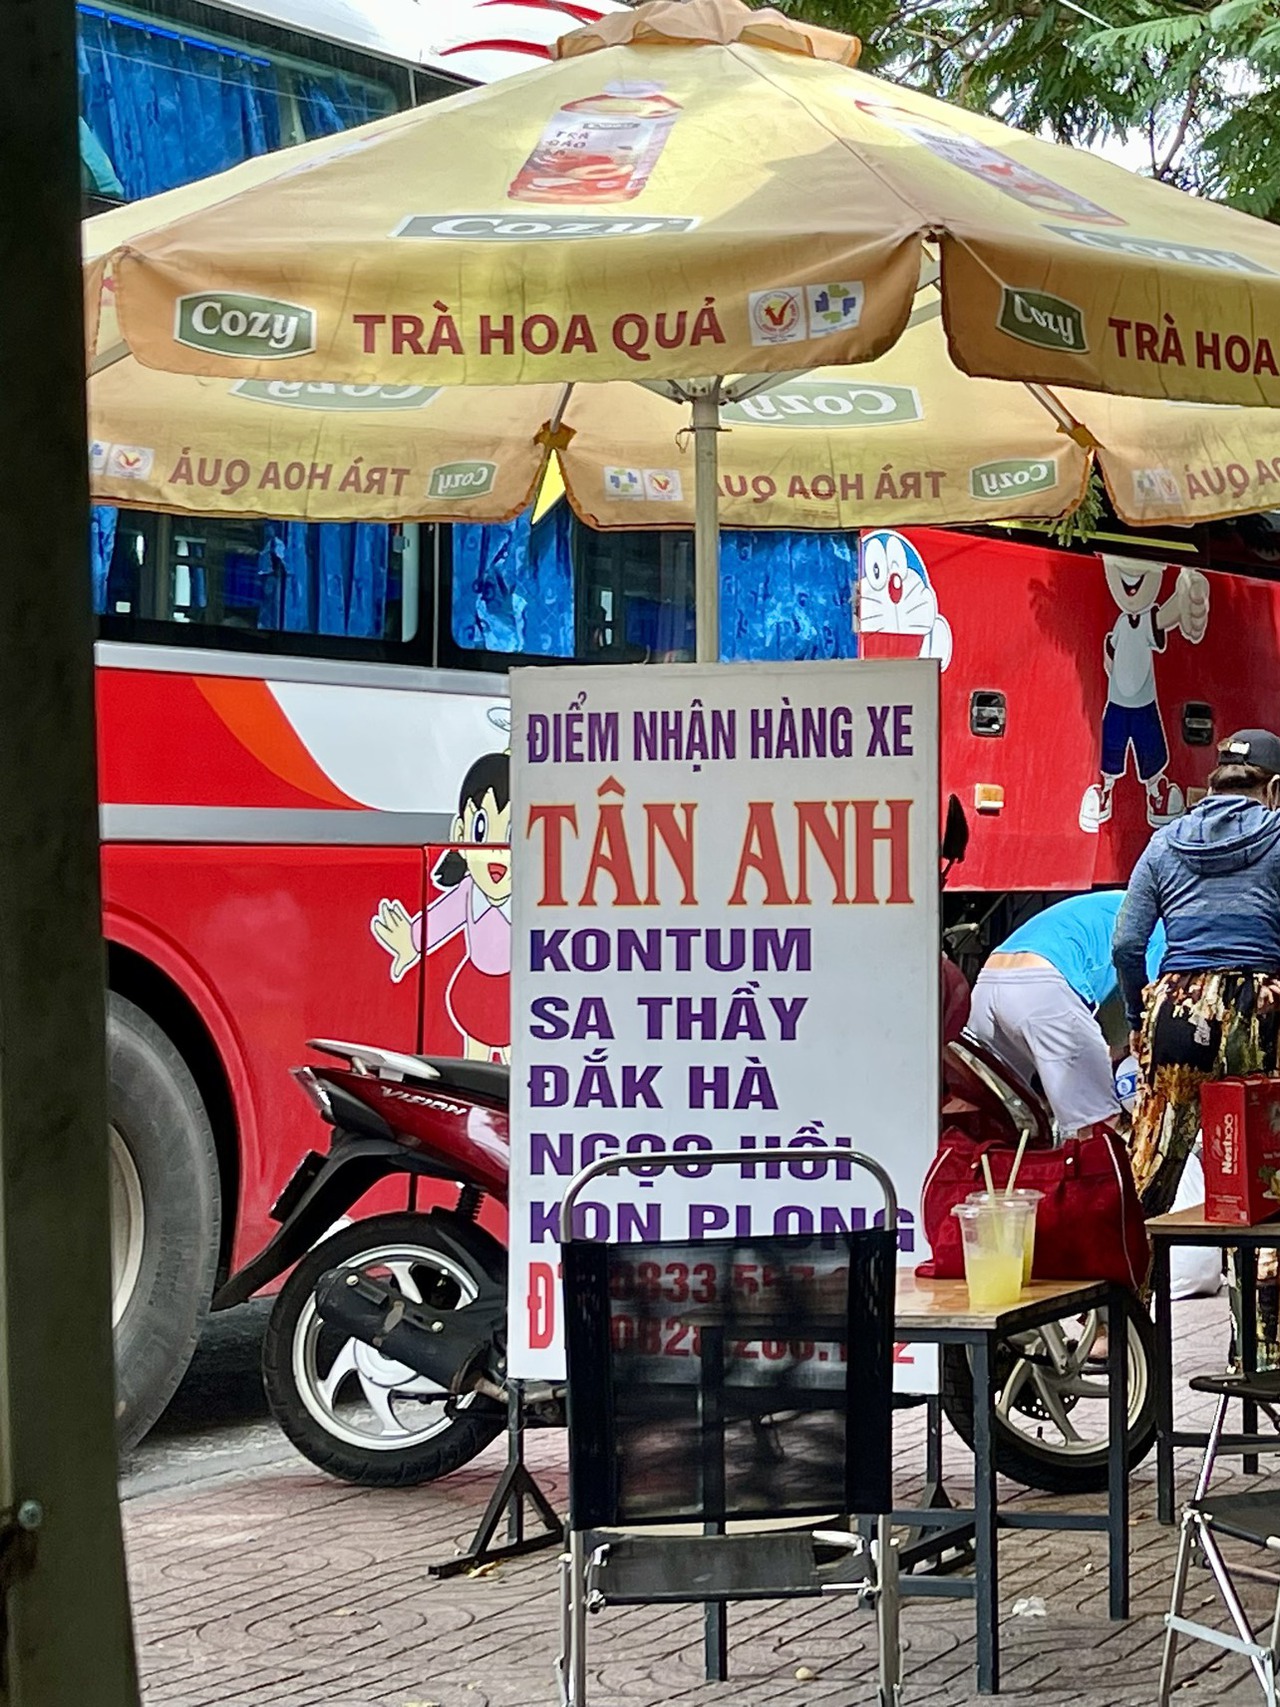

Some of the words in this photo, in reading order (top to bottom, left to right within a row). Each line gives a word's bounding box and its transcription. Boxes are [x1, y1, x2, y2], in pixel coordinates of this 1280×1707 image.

[431, 216, 661, 236] Cozy
[191, 301, 298, 349] Cozy
[353, 300, 463, 355] TRÀ
[480, 313, 598, 355] HOA
[612, 296, 726, 361] QUẢ
[1013, 293, 1074, 346] Cozy
[1108, 313, 1186, 366] TRÀ
[1195, 330, 1280, 377] HOA
[527, 691, 619, 763] ĐIỂM
[633, 699, 736, 772] NHẬN
[750, 696, 853, 759] HÀNG
[866, 705, 914, 758] XE
[526, 774, 699, 907] TÂN
[727, 799, 915, 906] ANH
[529, 928, 812, 972] KONTUM
[529, 996, 615, 1041] SA
[637, 981, 809, 1041] THẦY
[527, 1048, 663, 1109] ĐẮK
[688, 1056, 779, 1110] HÀ
[530, 1133, 713, 1188] NGỌC
[740, 1120, 852, 1180] HỒI
[530, 1201, 662, 1244] KON
